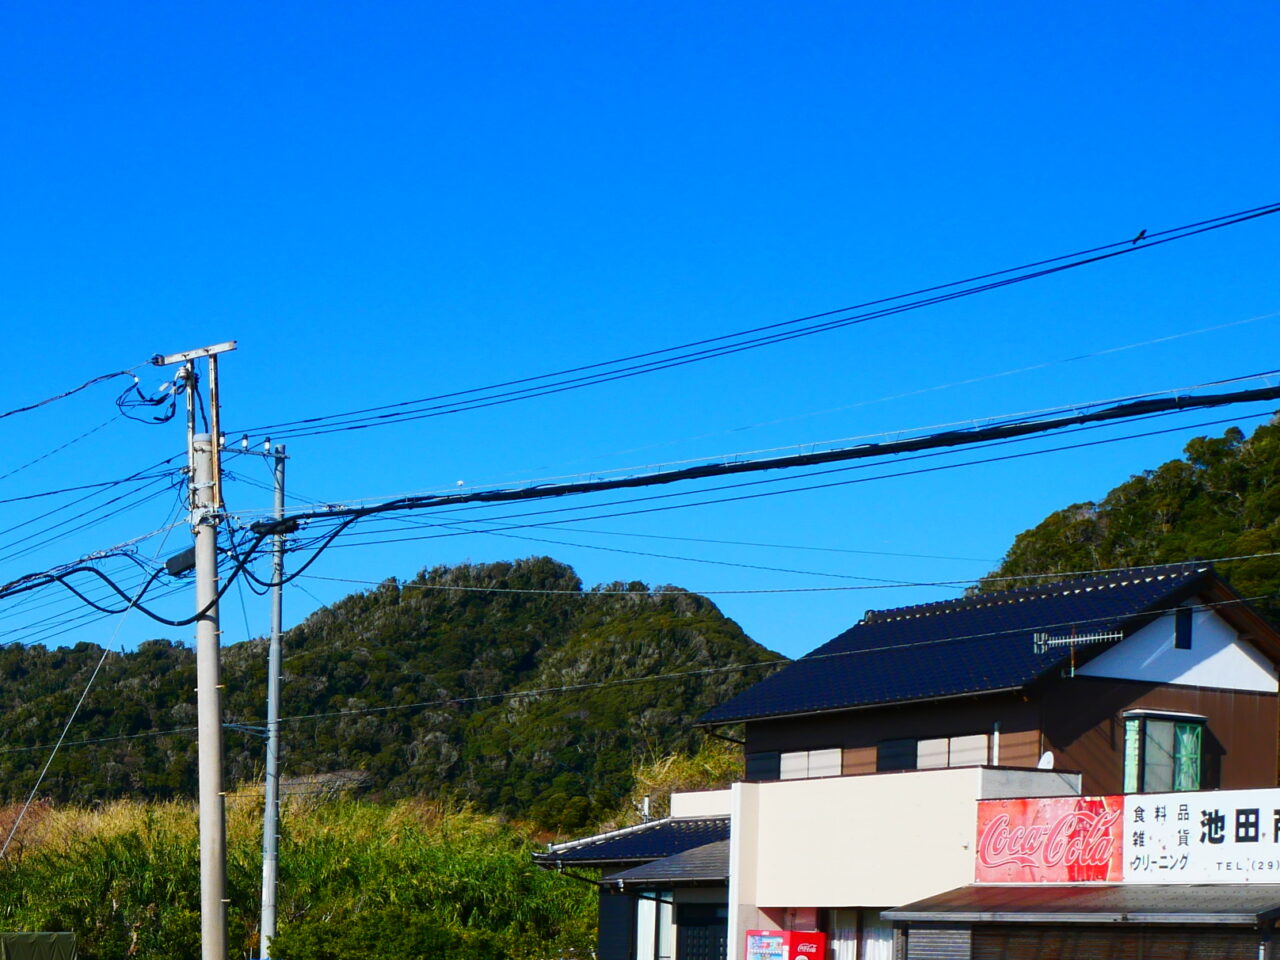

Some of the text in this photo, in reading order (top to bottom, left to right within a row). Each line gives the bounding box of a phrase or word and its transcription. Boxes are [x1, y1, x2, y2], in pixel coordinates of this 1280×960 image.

[1133, 804, 1189, 823] 食料品
[1200, 808, 1280, 845] 池田
[978, 810, 1121, 868] Coca-Cola
[1130, 852, 1189, 871] クリーニング
